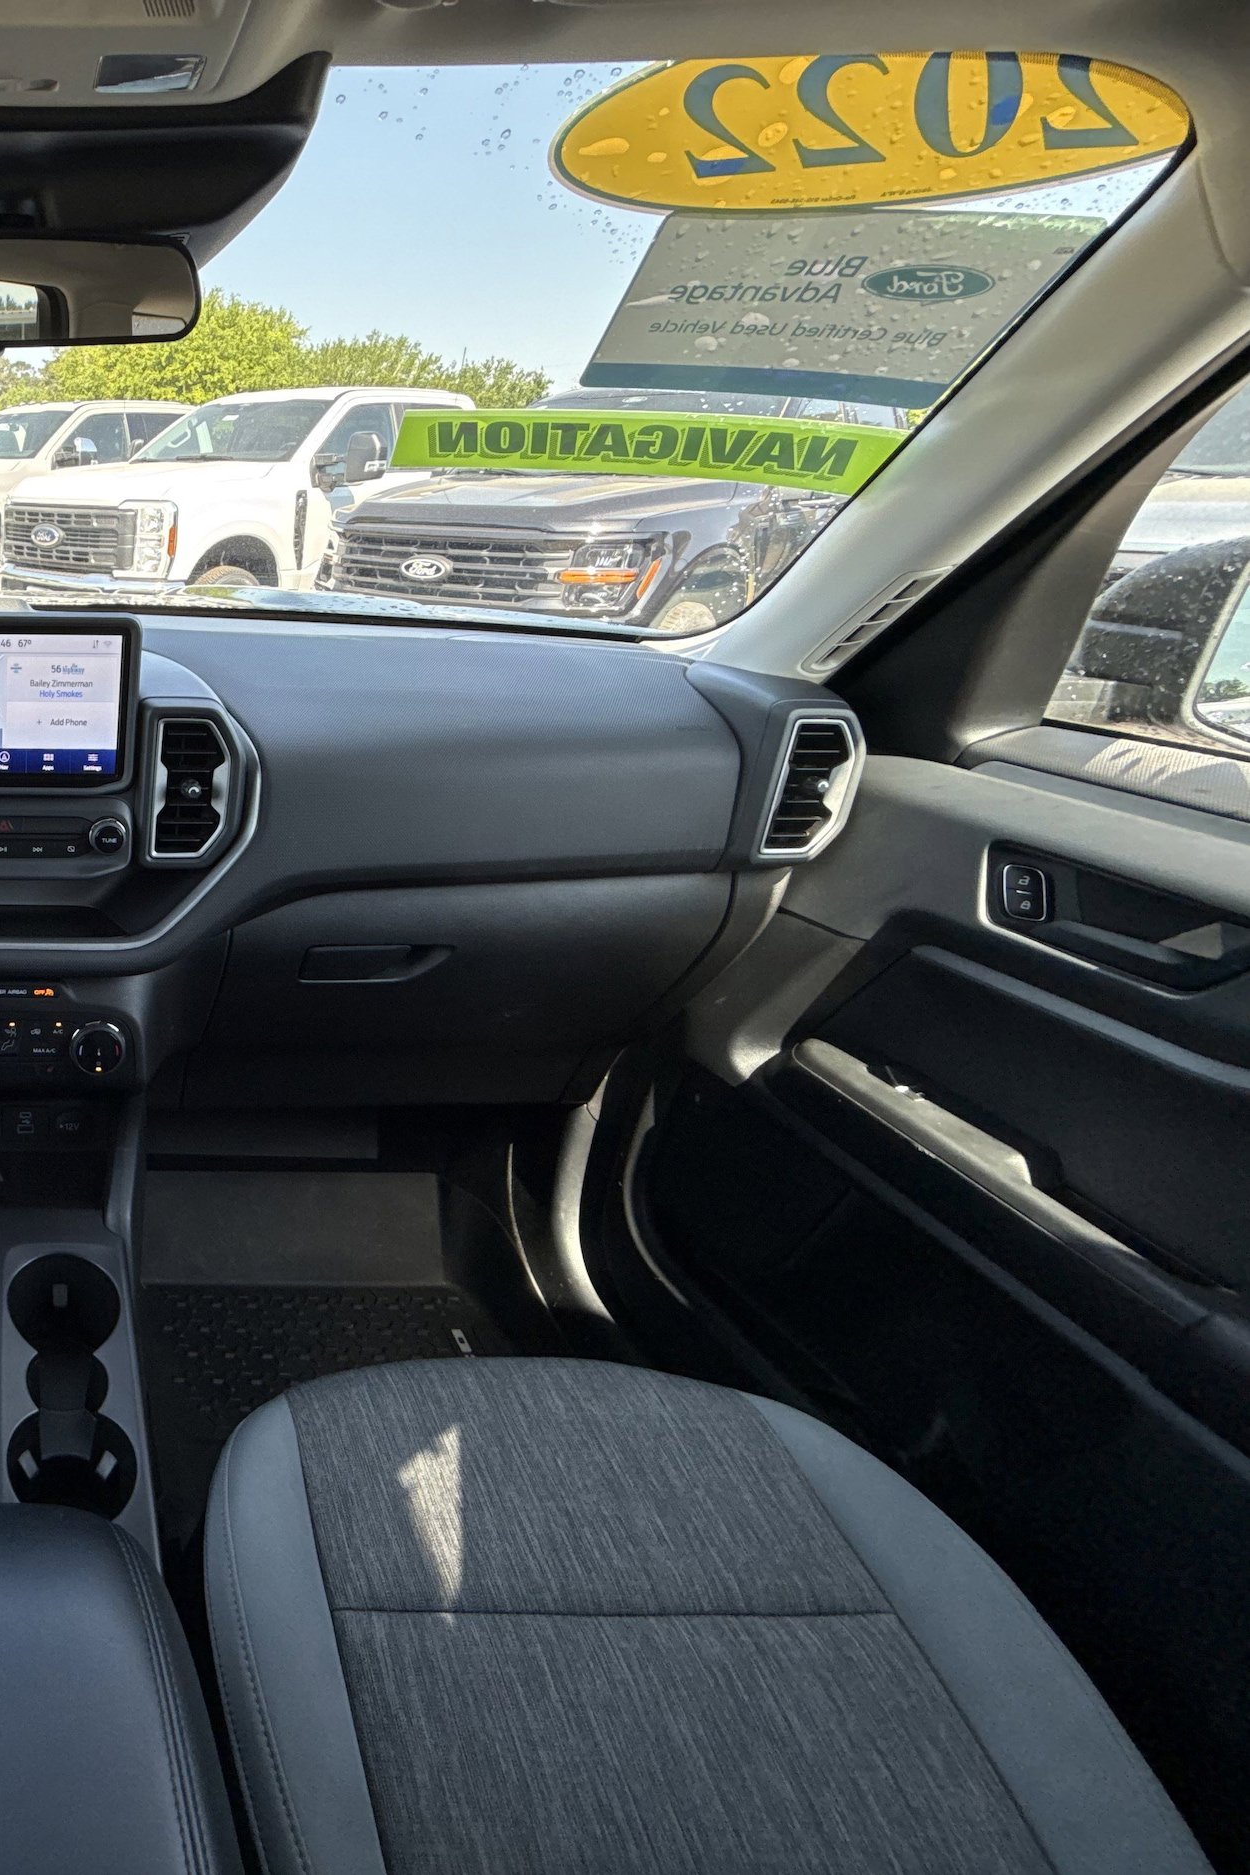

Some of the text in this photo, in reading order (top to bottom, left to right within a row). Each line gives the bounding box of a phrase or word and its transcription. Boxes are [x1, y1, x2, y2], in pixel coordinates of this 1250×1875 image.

[51, 665, 62, 674] 56
[30, 679, 93, 689] Bailey Zimmerman
[39, 690, 83, 699] Holy Smokes
[50, 718, 87, 726] Add Phone
[34, 988, 46, 996] OFF
